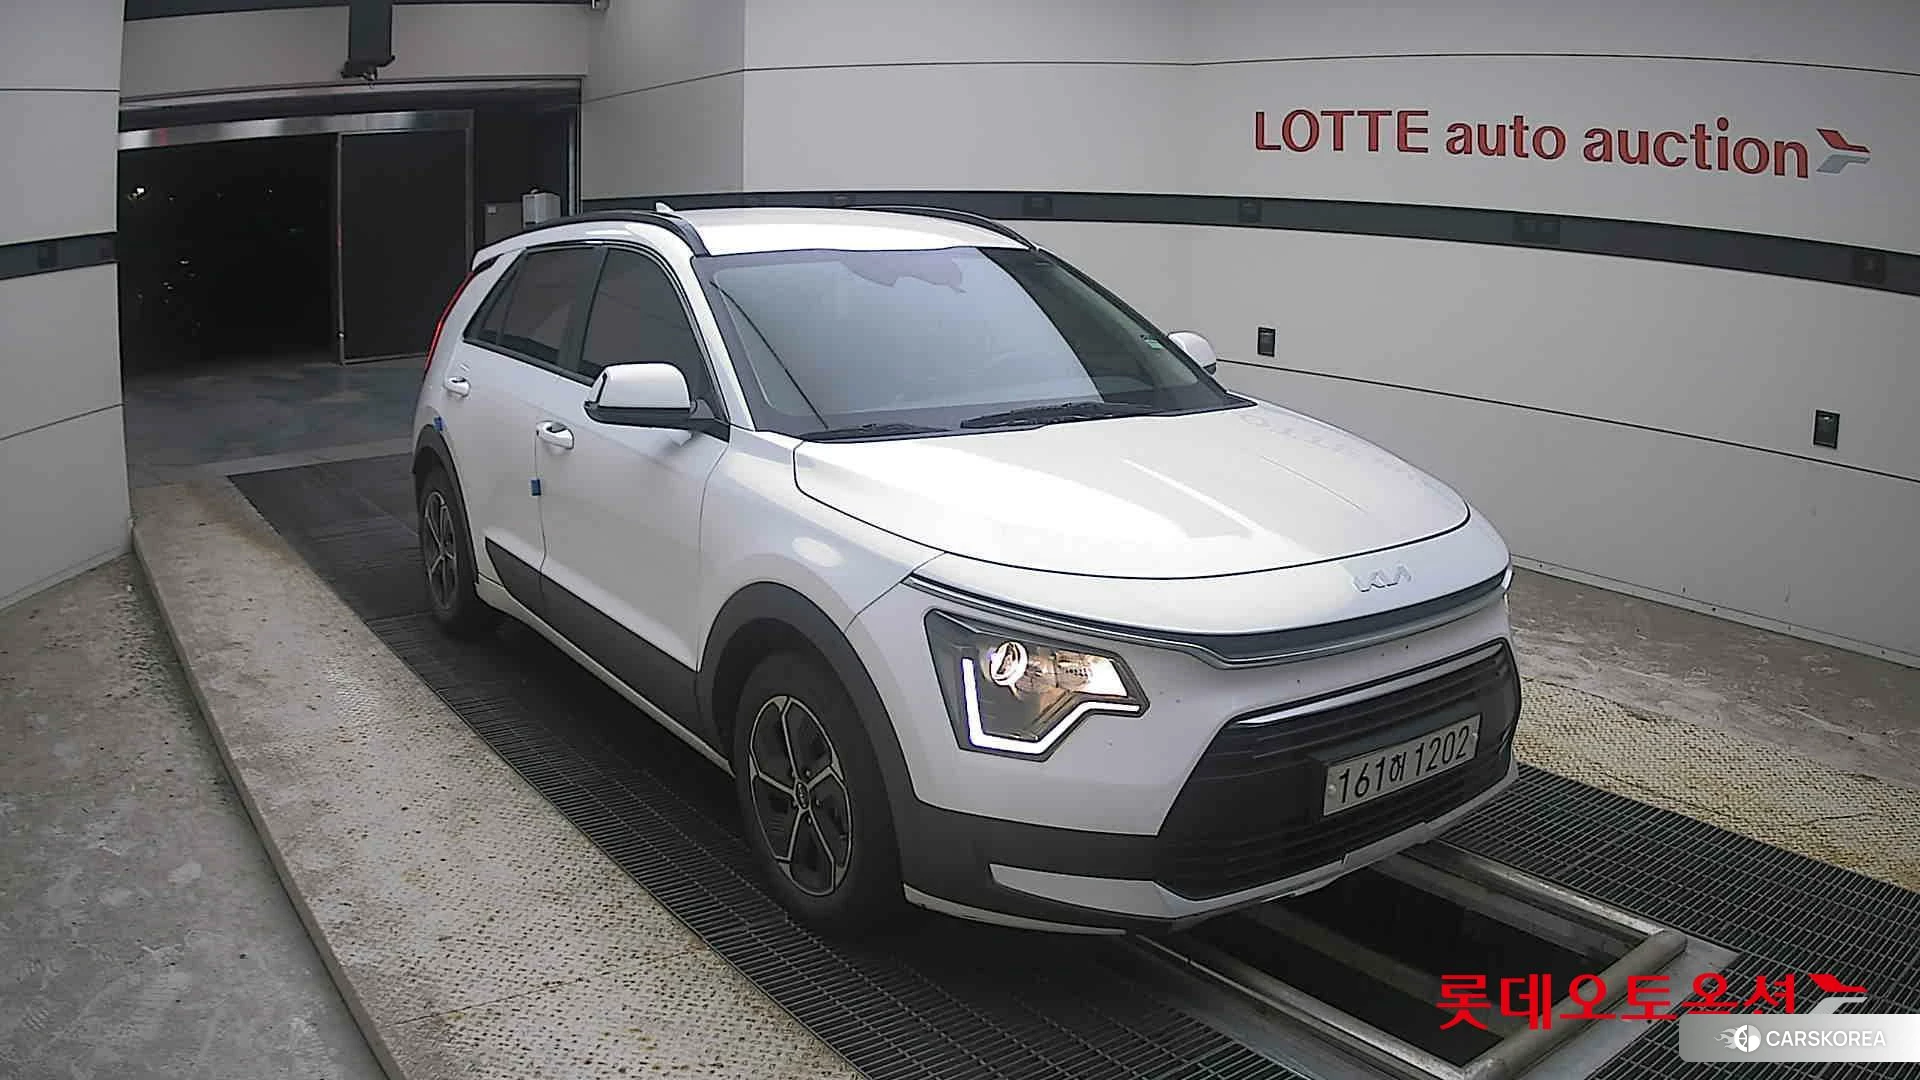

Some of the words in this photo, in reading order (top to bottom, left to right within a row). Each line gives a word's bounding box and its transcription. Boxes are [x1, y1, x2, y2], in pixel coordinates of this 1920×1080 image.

[1254, 109, 1429, 153] LOTTE
[1445, 115, 1568, 160] auto
[1582, 116, 1810, 179] auction
[1352, 563, 1412, 592] KIA
[1338, 751, 1408, 805] 161허
[1414, 724, 1470, 778] 1202
